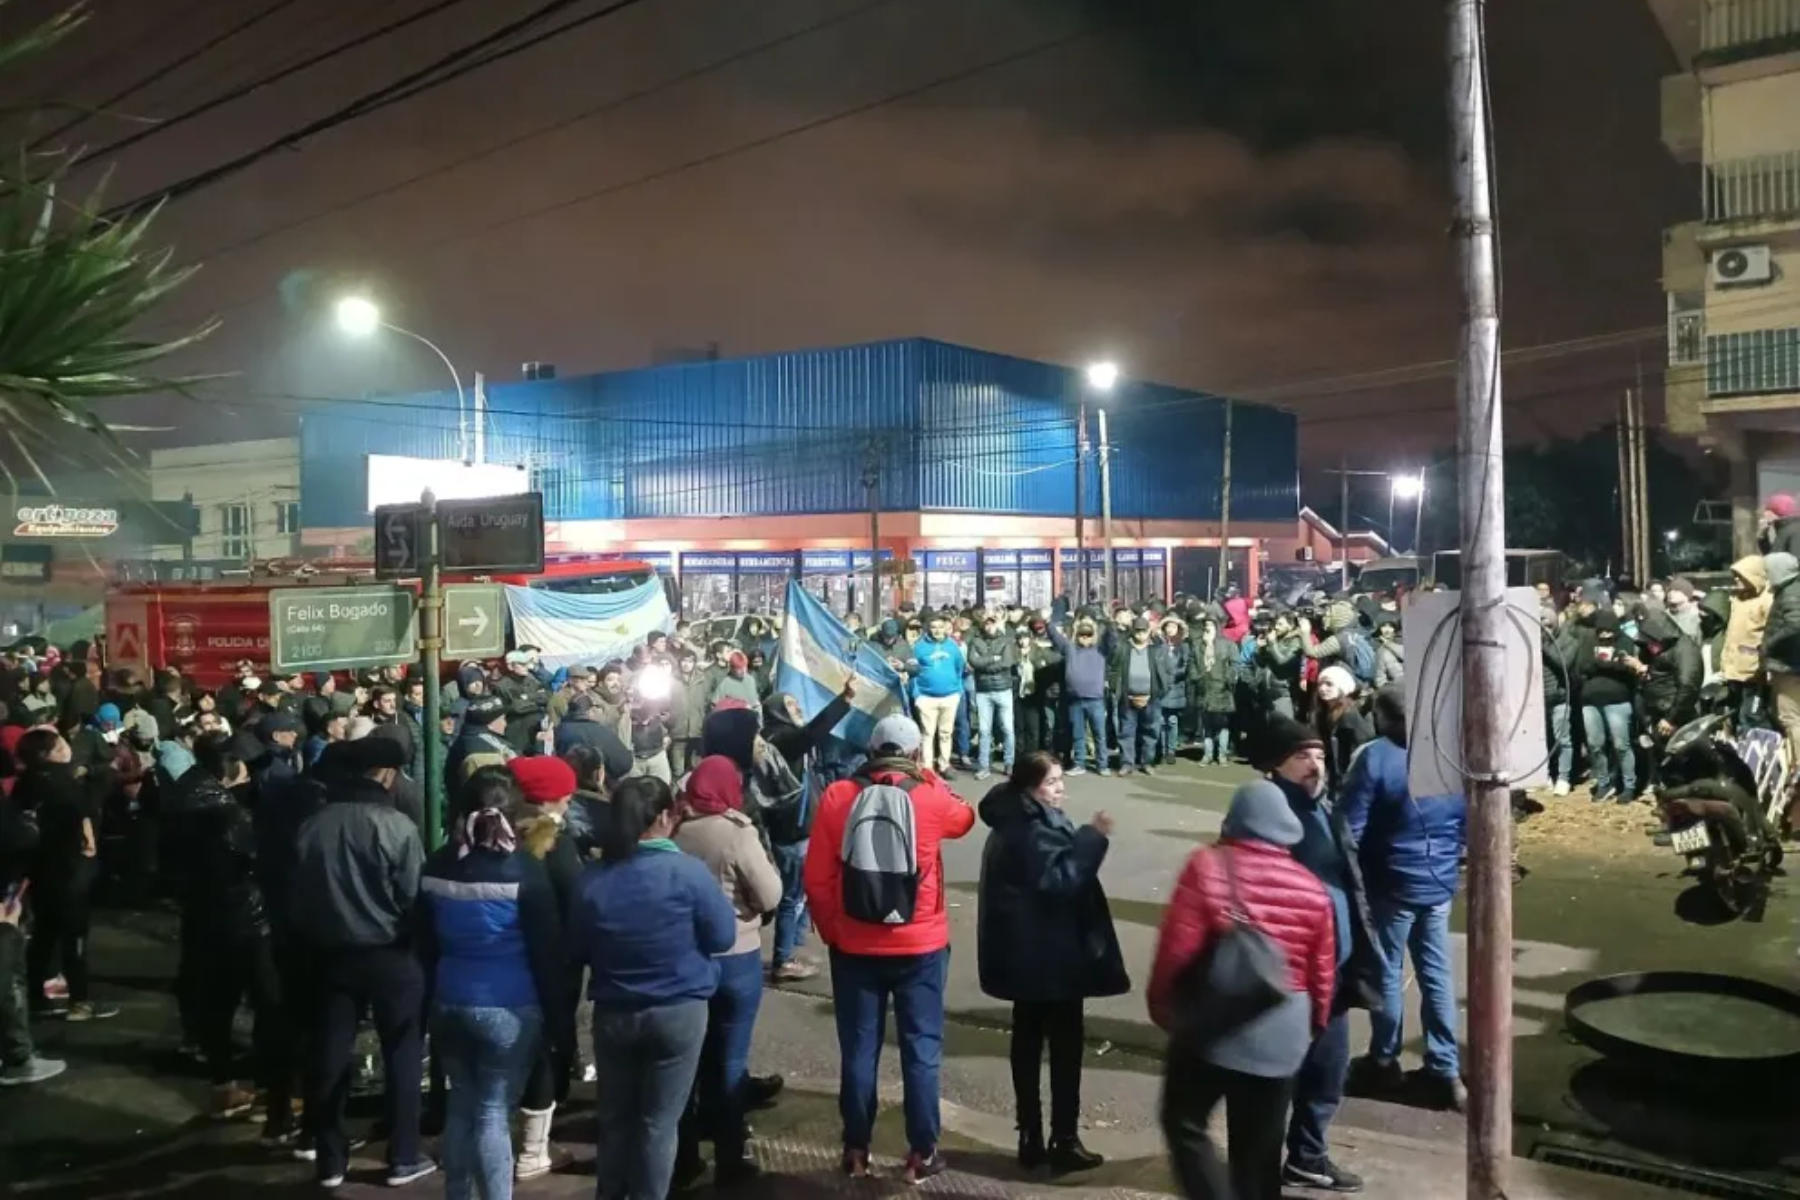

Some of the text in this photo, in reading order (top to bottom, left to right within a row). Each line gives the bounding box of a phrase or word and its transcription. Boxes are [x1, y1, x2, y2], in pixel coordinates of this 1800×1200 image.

[480, 511, 529, 530] Uruguay
[287, 602, 388, 621] Felix Bogado
[291, 644, 322, 659] 2100
